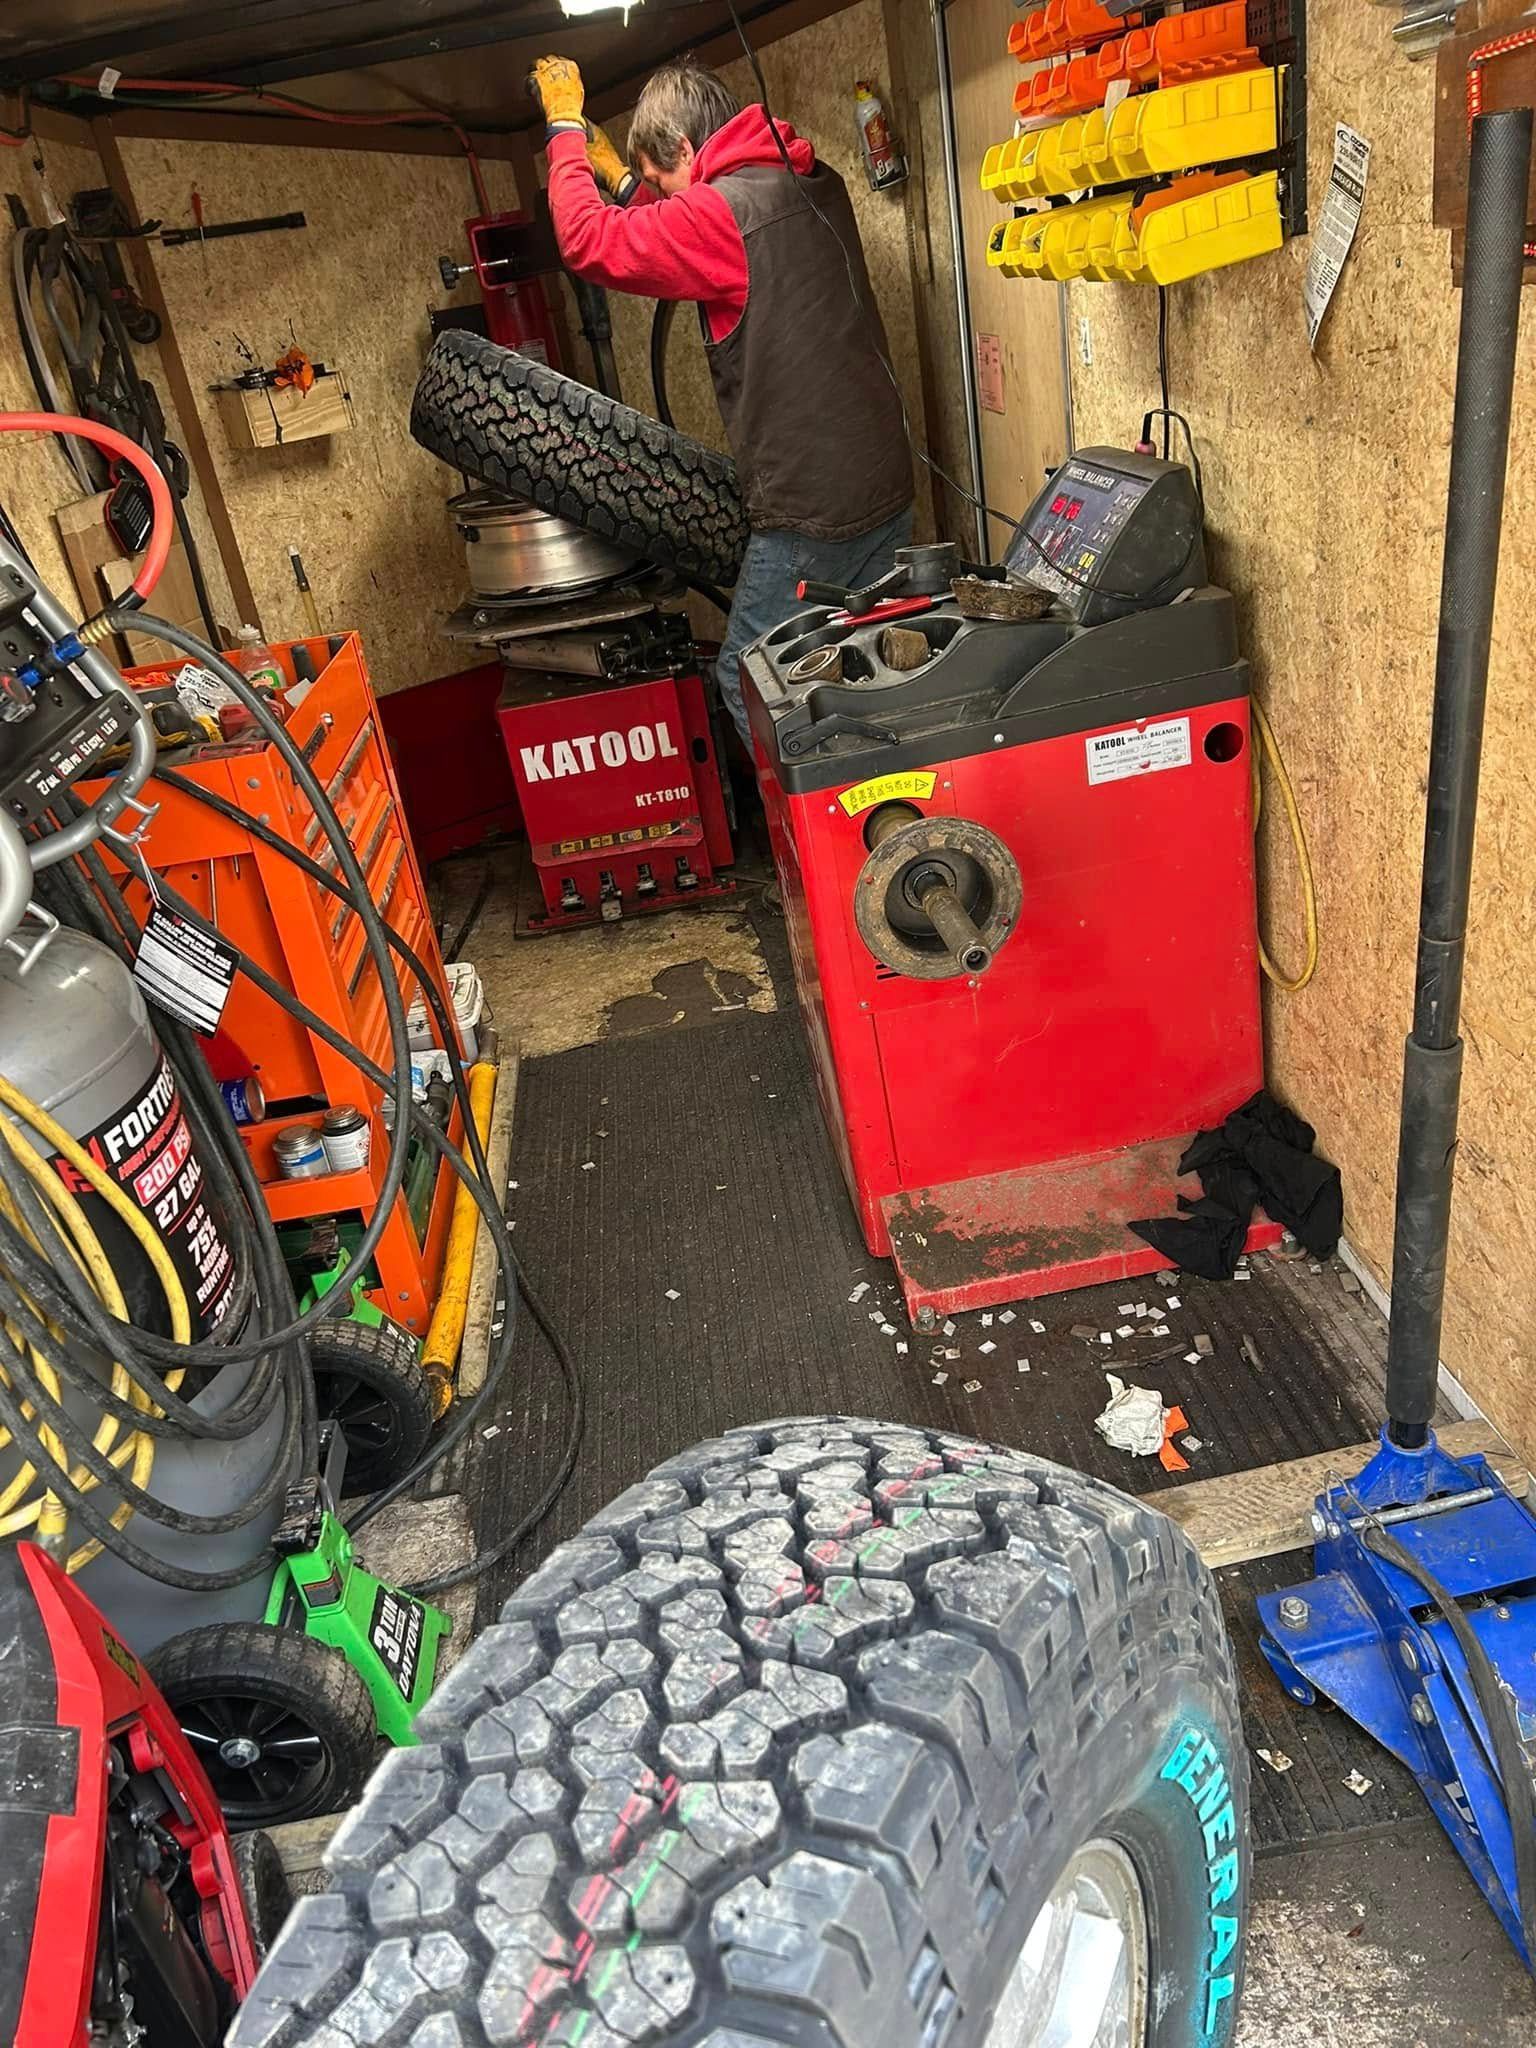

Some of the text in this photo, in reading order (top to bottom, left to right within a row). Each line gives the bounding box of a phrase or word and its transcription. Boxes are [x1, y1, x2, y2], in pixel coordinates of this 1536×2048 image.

[1083, 471, 1115, 489] BALANCER
[519, 722, 679, 783] KATOOL
[1094, 726, 1182, 751] KATOOL WHEEL BALANCER
[635, 786, 690, 807] KT-T810
[139, 1152, 176, 1199] 200
[154, 1186, 179, 1229] 27
[178, 1155, 202, 1200] GAL
[186, 1203, 205, 1234] up to
[187, 1214, 217, 1266] 75%
[196, 1244, 229, 1304] RUNTIME
[199, 1238, 221, 1278] MORE
[373, 1594, 400, 1664] 3 TON
[399, 1604, 421, 1697] DAYTONA
[1160, 1727, 1239, 2035] GENERAL
